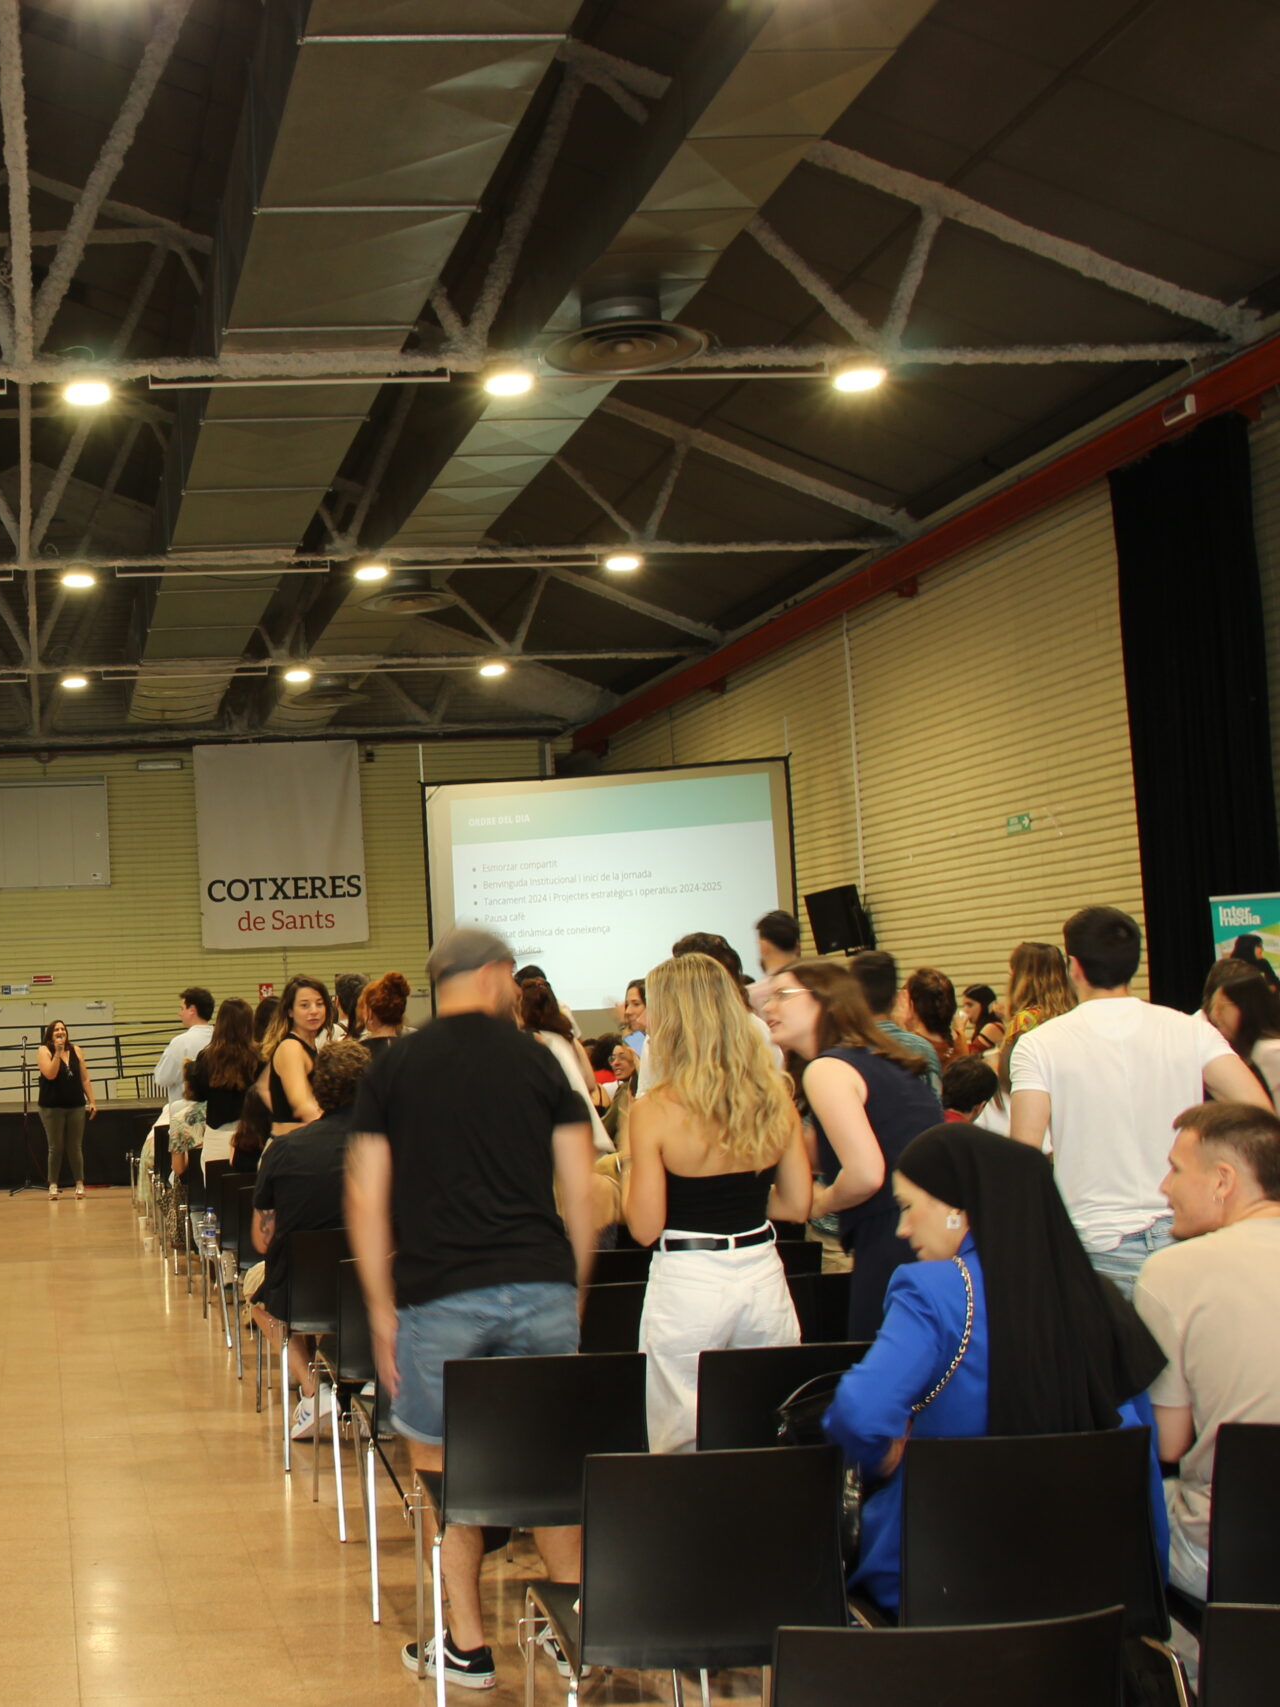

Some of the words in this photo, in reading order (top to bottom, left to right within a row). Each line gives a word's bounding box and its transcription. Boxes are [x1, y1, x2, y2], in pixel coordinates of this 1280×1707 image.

[468, 816, 497, 827] ORDRE
[498, 815, 513, 825] DEL
[515, 813, 531, 824] DIA
[482, 863, 518, 873] Esmorzar
[519, 860, 558, 873] compartit
[483, 879, 528, 891] Benvinguda
[600, 872, 611, 882] de
[612, 871, 620, 880] la
[621, 869, 652, 882] jornada
[207, 875, 362, 903] COTXERES
[484, 895, 527, 907] Tancament
[528, 893, 548, 904] 2024
[553, 890, 590, 903] Projectes
[591, 888, 634, 901] estratègics
[639, 885, 678, 897] operatius
[679, 881, 722, 894] 2024-2025
[484, 912, 508, 923] Pausa
[1218, 905, 1251, 919] Inter
[238, 910, 266, 932] de
[272, 909, 336, 931] Sants
[1220, 912, 1262, 927] media
[518, 927, 553, 938] dinàmica
[554, 926, 565, 936] de
[566, 924, 611, 936] coneixença
